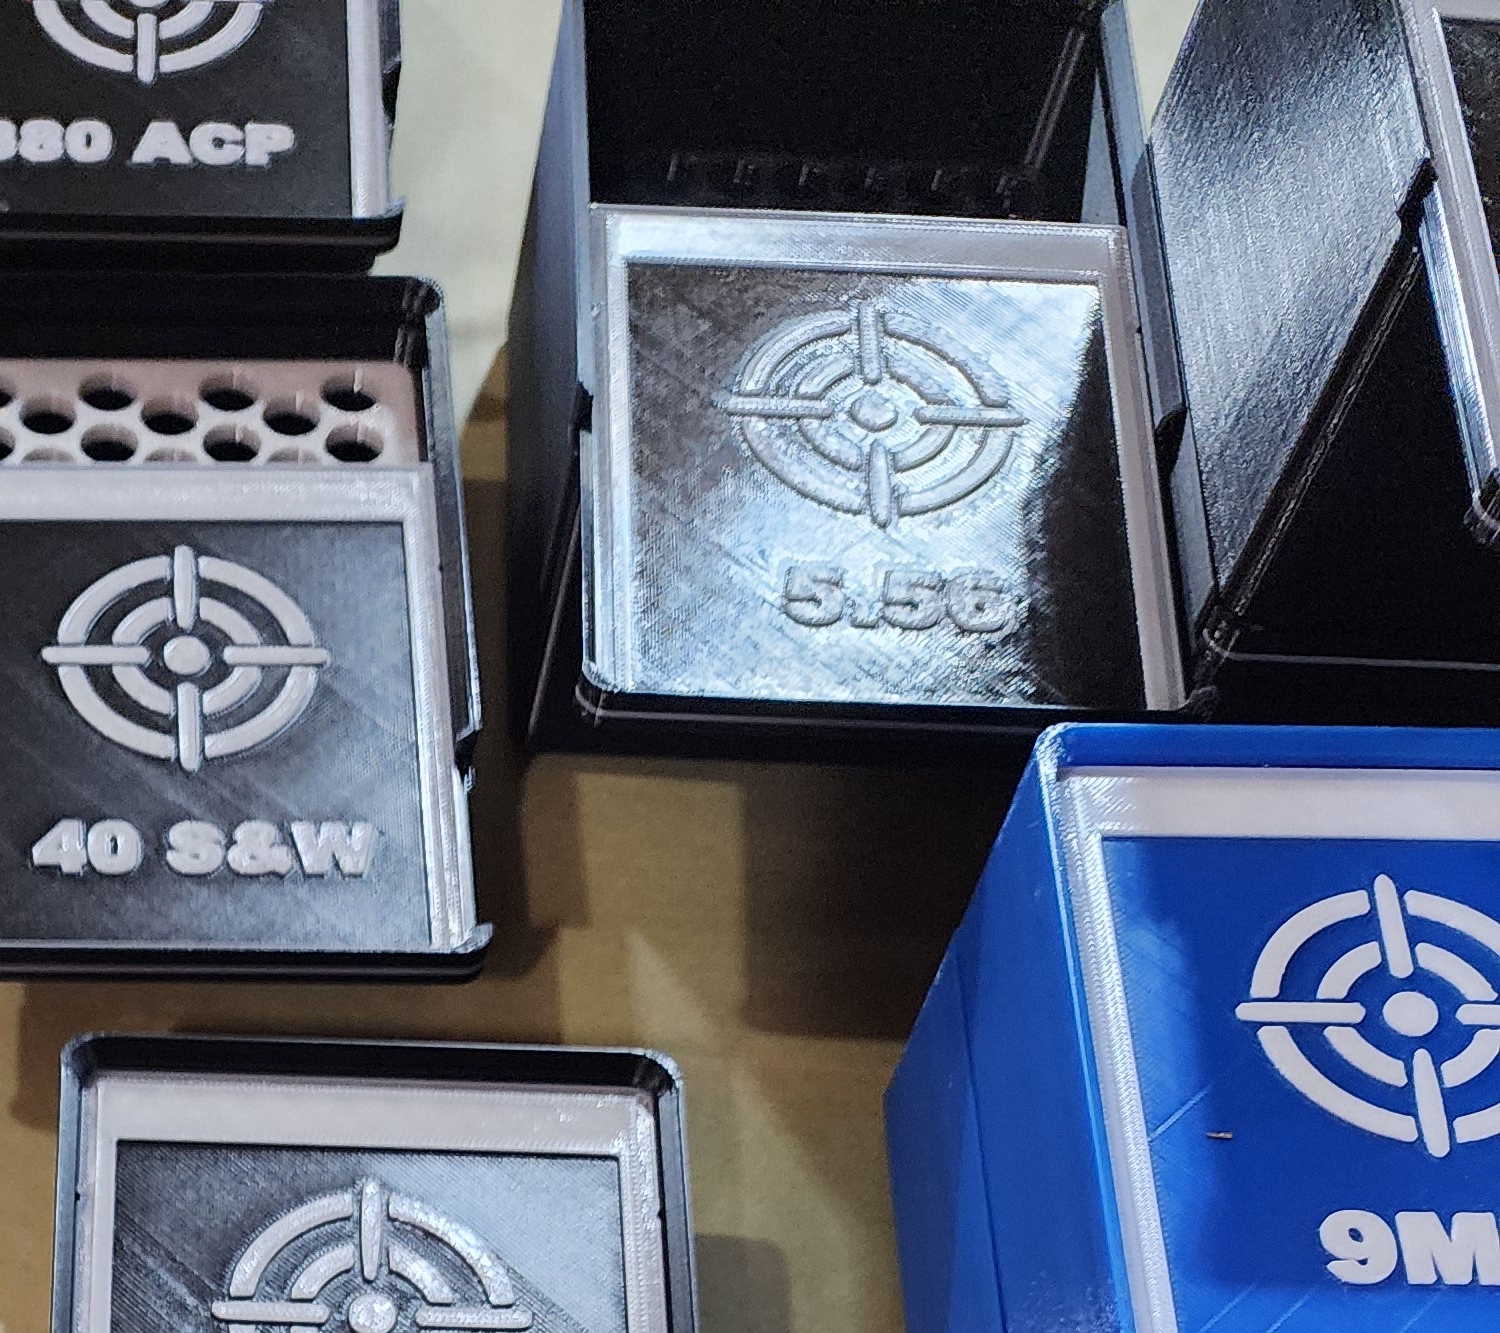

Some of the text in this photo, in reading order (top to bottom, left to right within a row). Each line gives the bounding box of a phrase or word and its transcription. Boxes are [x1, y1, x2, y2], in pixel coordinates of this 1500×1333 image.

[130, 120, 296, 166] ACP
[783, 563, 1020, 633] 5.56
[30, 818, 374, 877] 40 S&W
